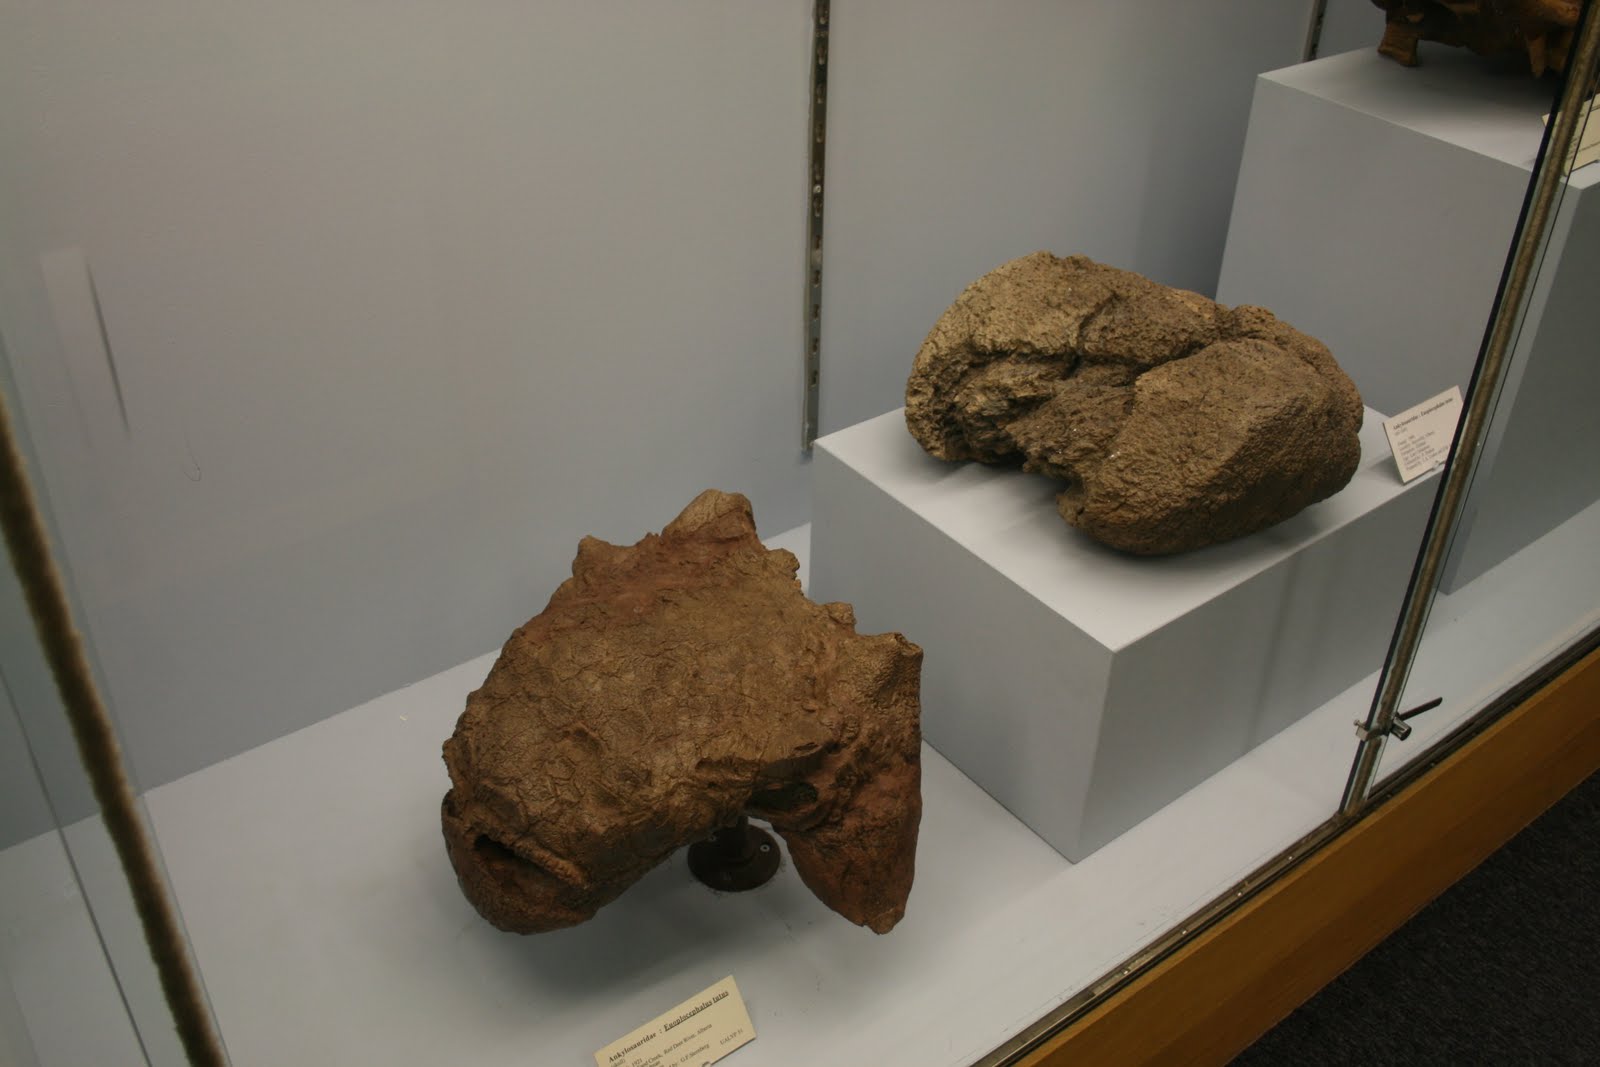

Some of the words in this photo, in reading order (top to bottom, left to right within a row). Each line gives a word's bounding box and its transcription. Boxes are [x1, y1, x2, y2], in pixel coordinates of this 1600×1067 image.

[609, 1032, 657, 1063] Ankylosauridae
[663, 1000, 713, 1032] Euoplocephalus
[712, 990, 729, 1004] tutus
